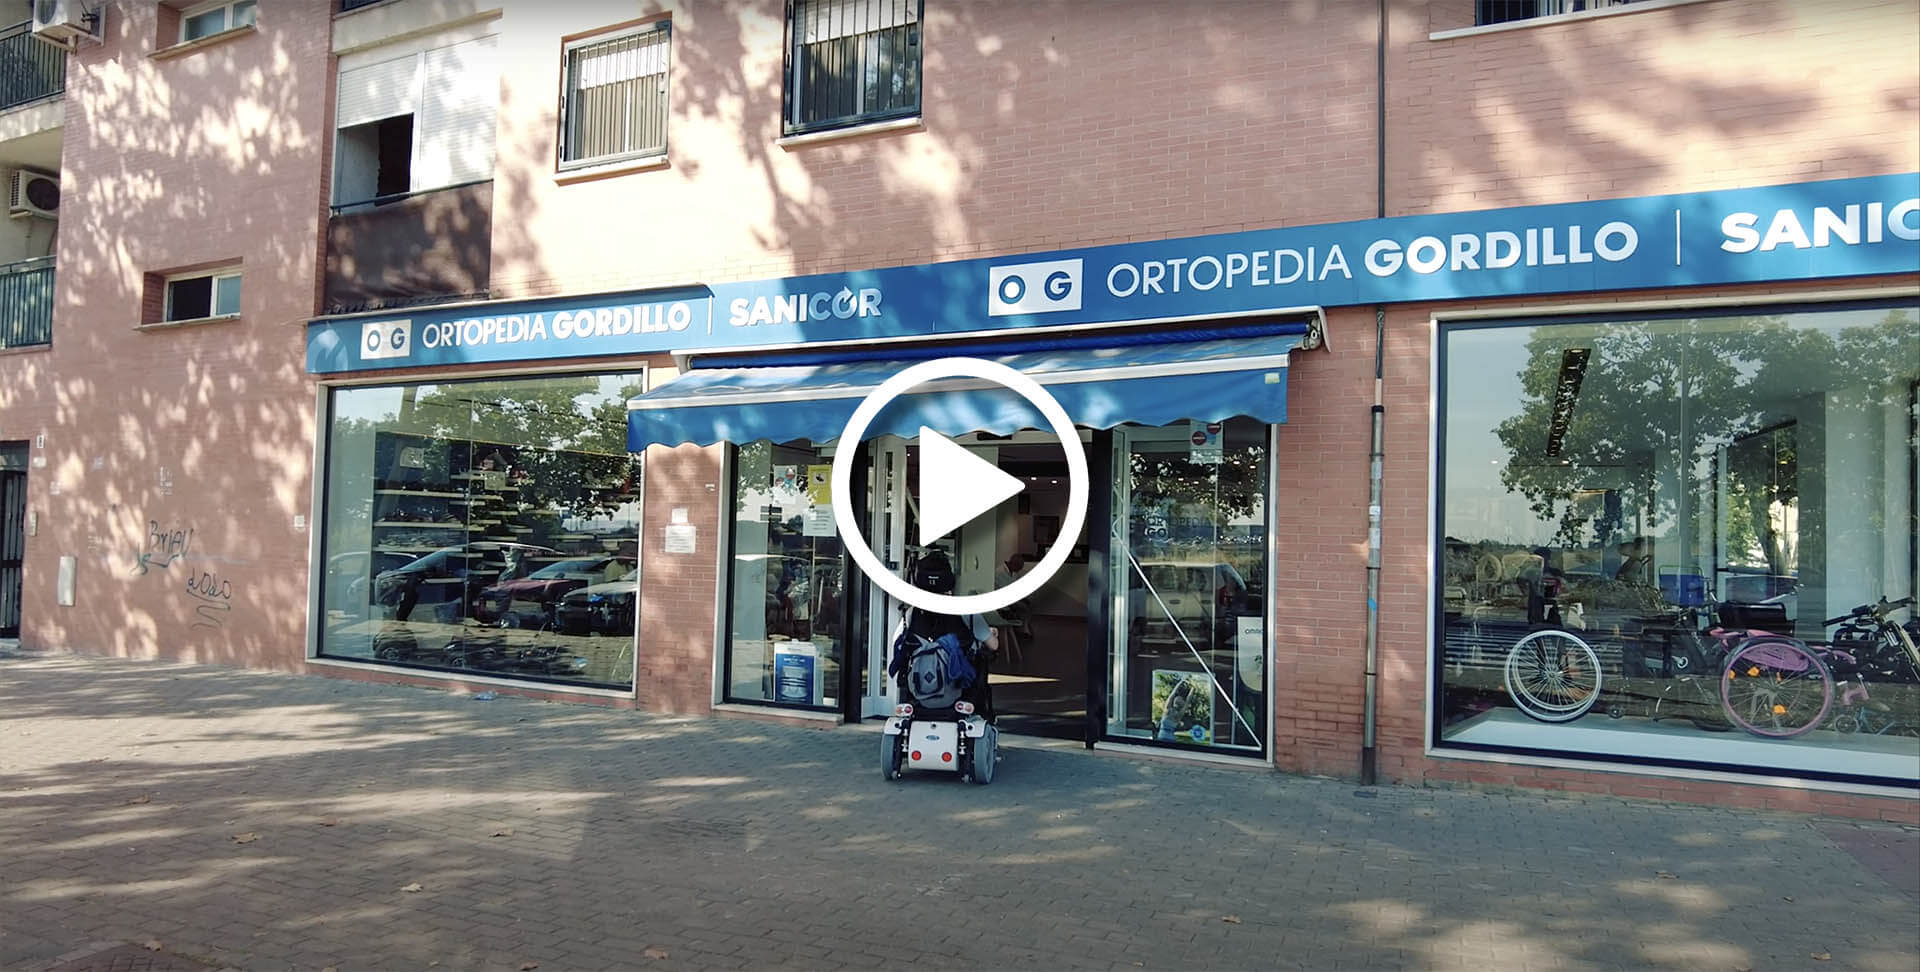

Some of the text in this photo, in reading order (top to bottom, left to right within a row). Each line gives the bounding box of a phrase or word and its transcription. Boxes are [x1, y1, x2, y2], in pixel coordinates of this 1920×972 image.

[1107, 244, 1353, 297] ORTOPEDIA
[1364, 221, 1639, 277] GORDILLO
[1720, 198, 1920, 254] SANIC
[422, 313, 548, 349] ORTOPEDIA
[551, 302, 692, 340] GORDILLO
[729, 286, 882, 327] SANICOR
